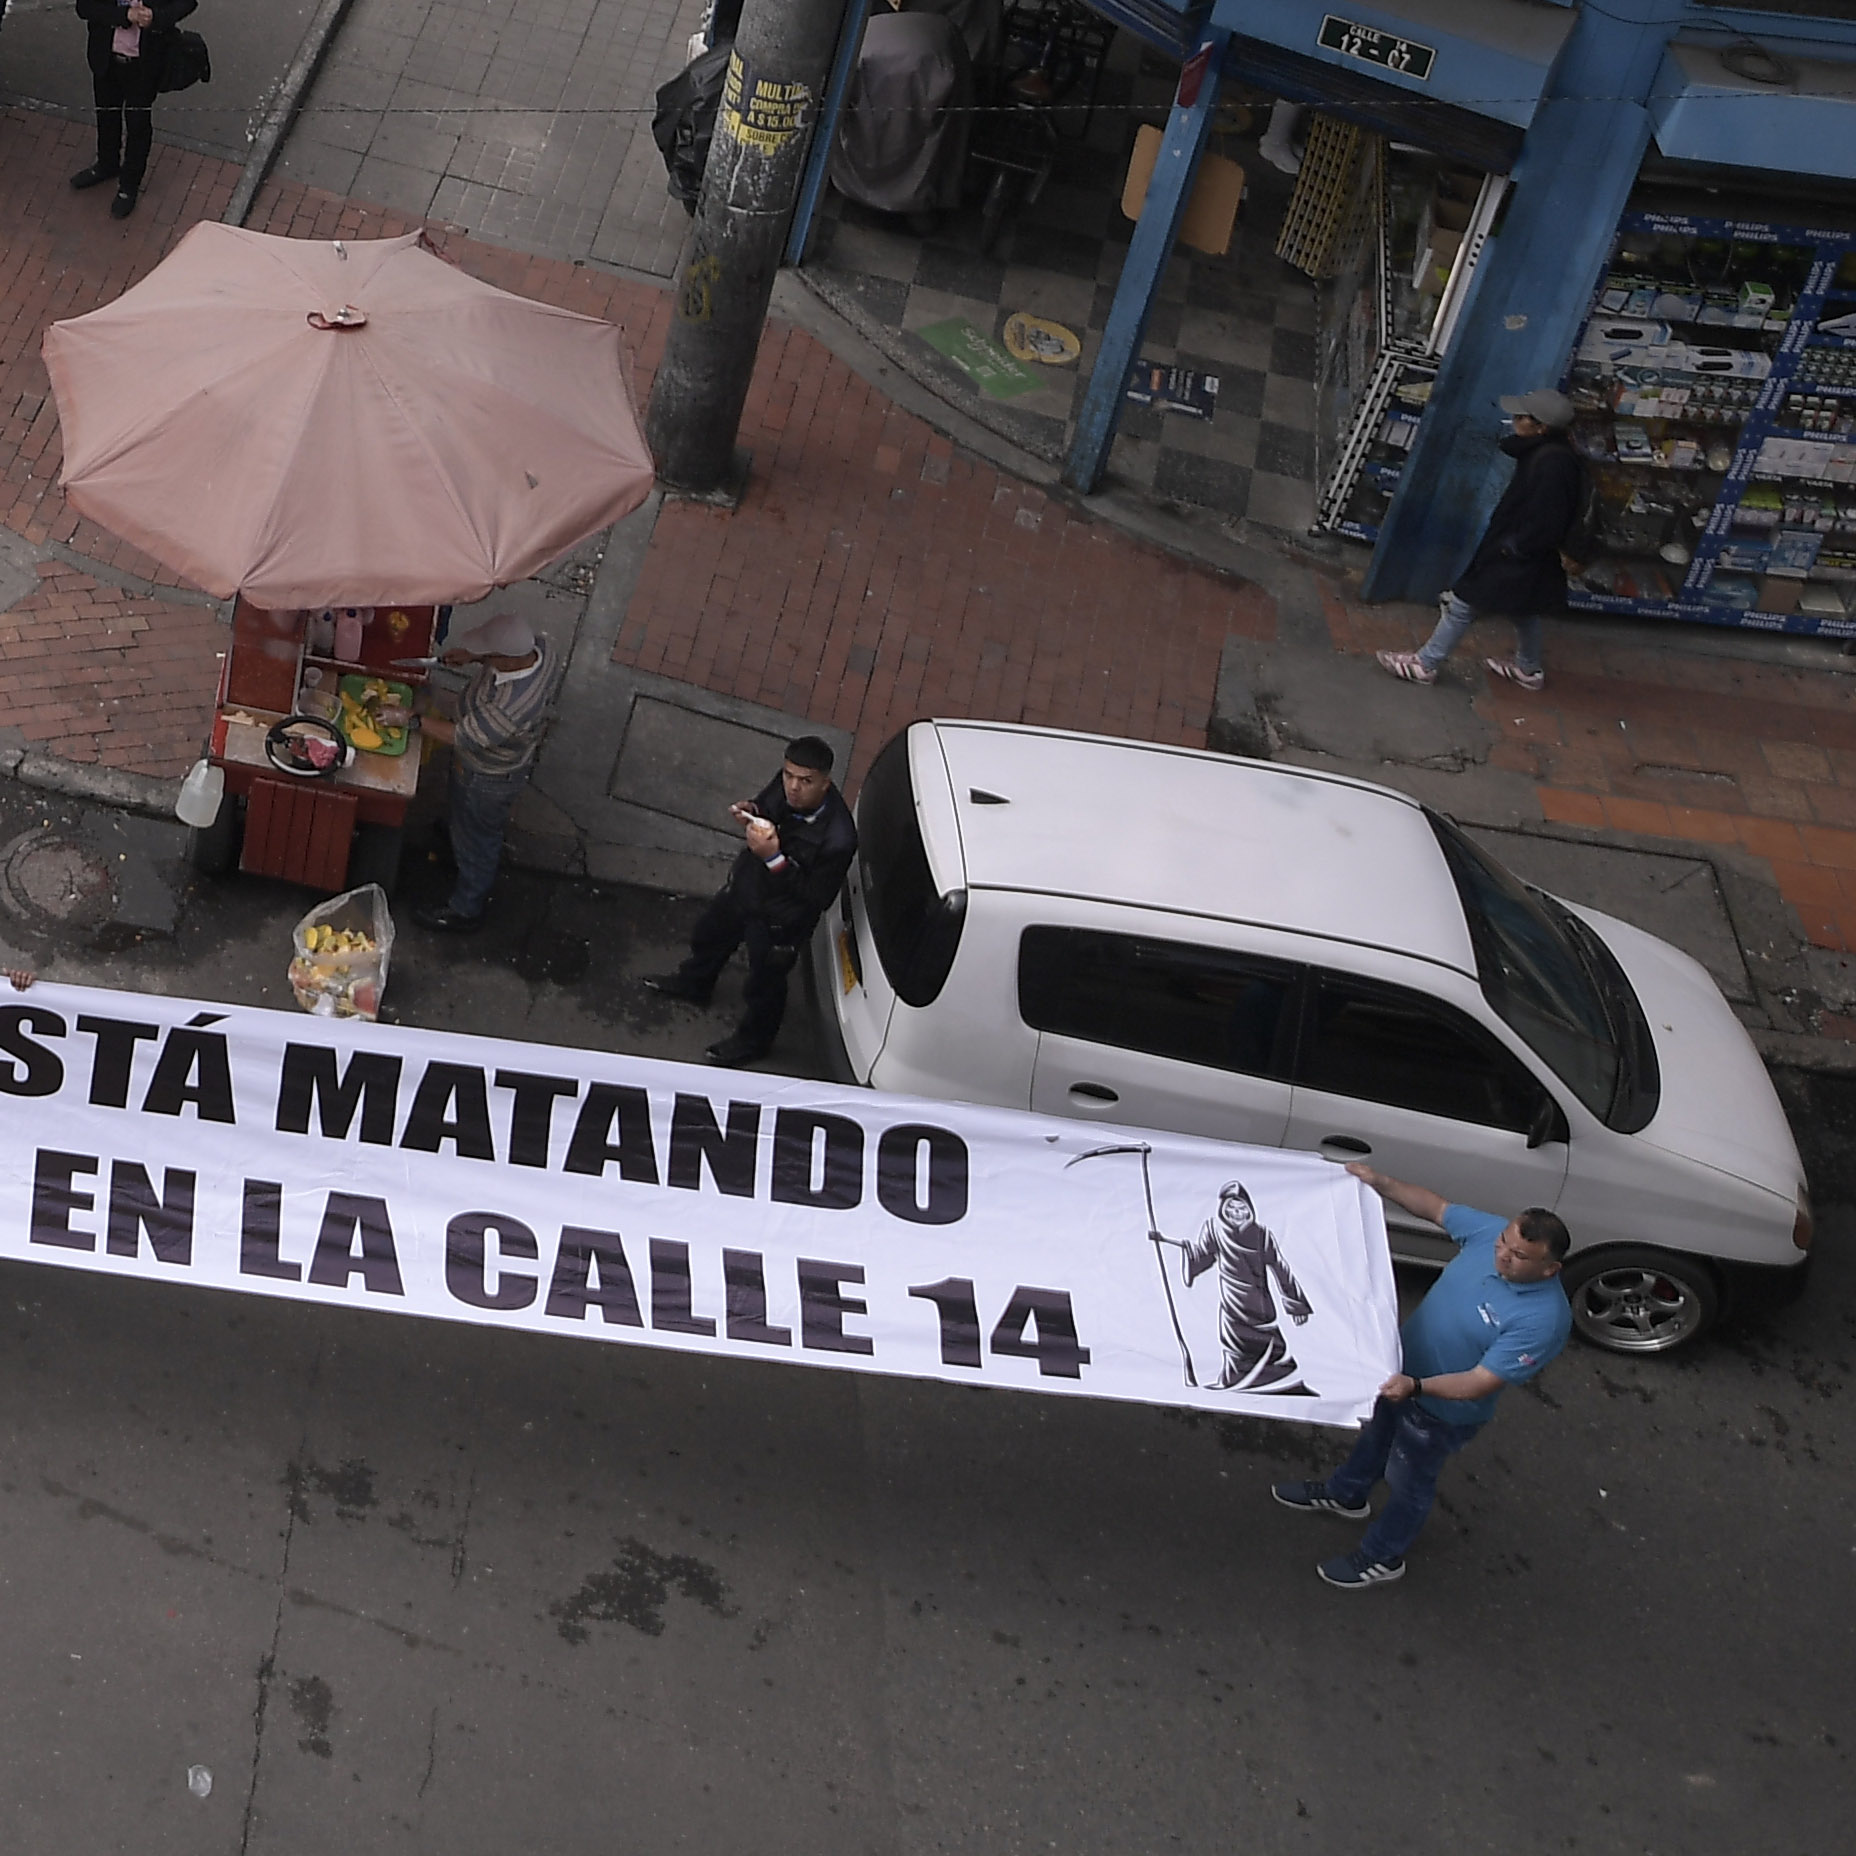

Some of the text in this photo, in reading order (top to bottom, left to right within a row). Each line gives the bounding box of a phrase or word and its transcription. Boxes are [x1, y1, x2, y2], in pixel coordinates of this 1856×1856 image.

[1339, 32, 1362, 57] 12
[1348, 25, 1380, 44] CALLE
[276, 1042, 971, 1227] MATANDO
[29, 1147, 198, 1267] EN
[240, 1176, 403, 1297] LA
[443, 1209, 877, 1356] CALLE
[908, 1274, 1093, 1380] 14
